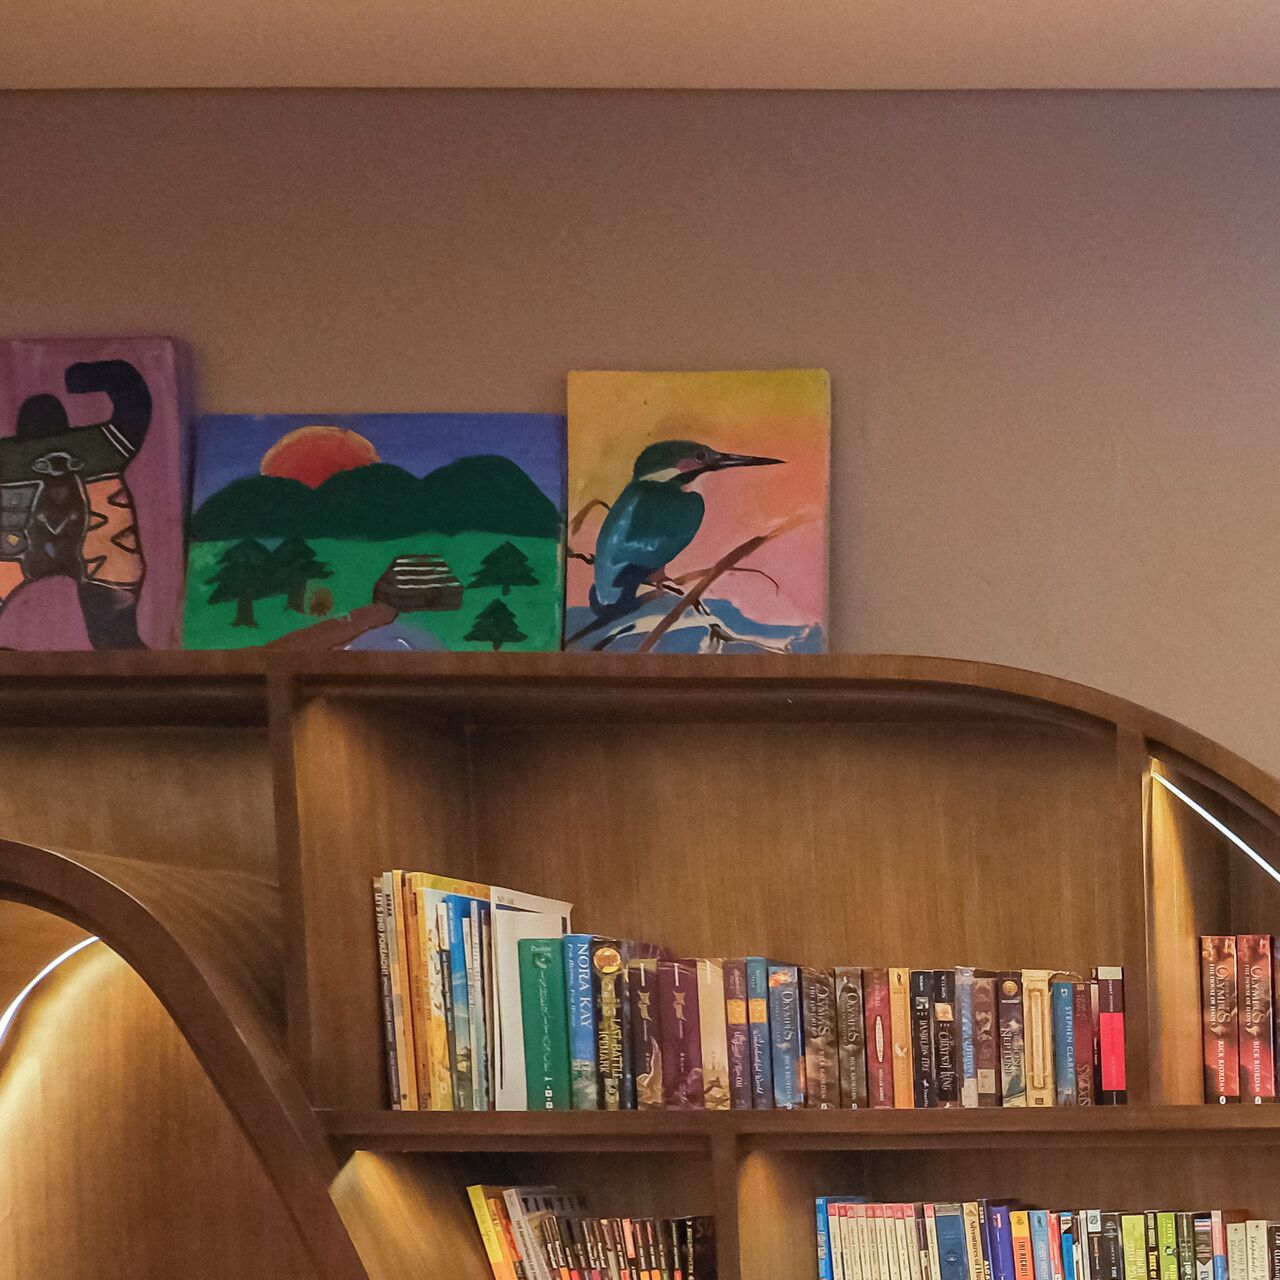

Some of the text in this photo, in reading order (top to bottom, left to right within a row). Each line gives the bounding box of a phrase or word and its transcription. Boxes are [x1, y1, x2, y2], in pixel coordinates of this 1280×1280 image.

[375, 893, 383, 912] LET'S
[376, 913, 384, 931] FIND
[577, 944, 592, 1029] NORA KAY
[1216, 965, 1230, 1023] OLYMPUS
[1251, 965, 1264, 1023] OLYMPUS
[782, 991, 795, 1040] OLYMPUS
[847, 992, 859, 1041] OLYMPUS
[598, 1031, 609, 1072] ICEMARK
[612, 1044, 623, 1079] BATTLE
[1066, 1046, 1074, 1078] CLARKE
[942, 1071, 956, 1090] KING
[970, 1219, 979, 1257] Adventures
[1020, 1253, 1029, 1277] RECRUIT
[1149, 1251, 1157, 1269] THREE
